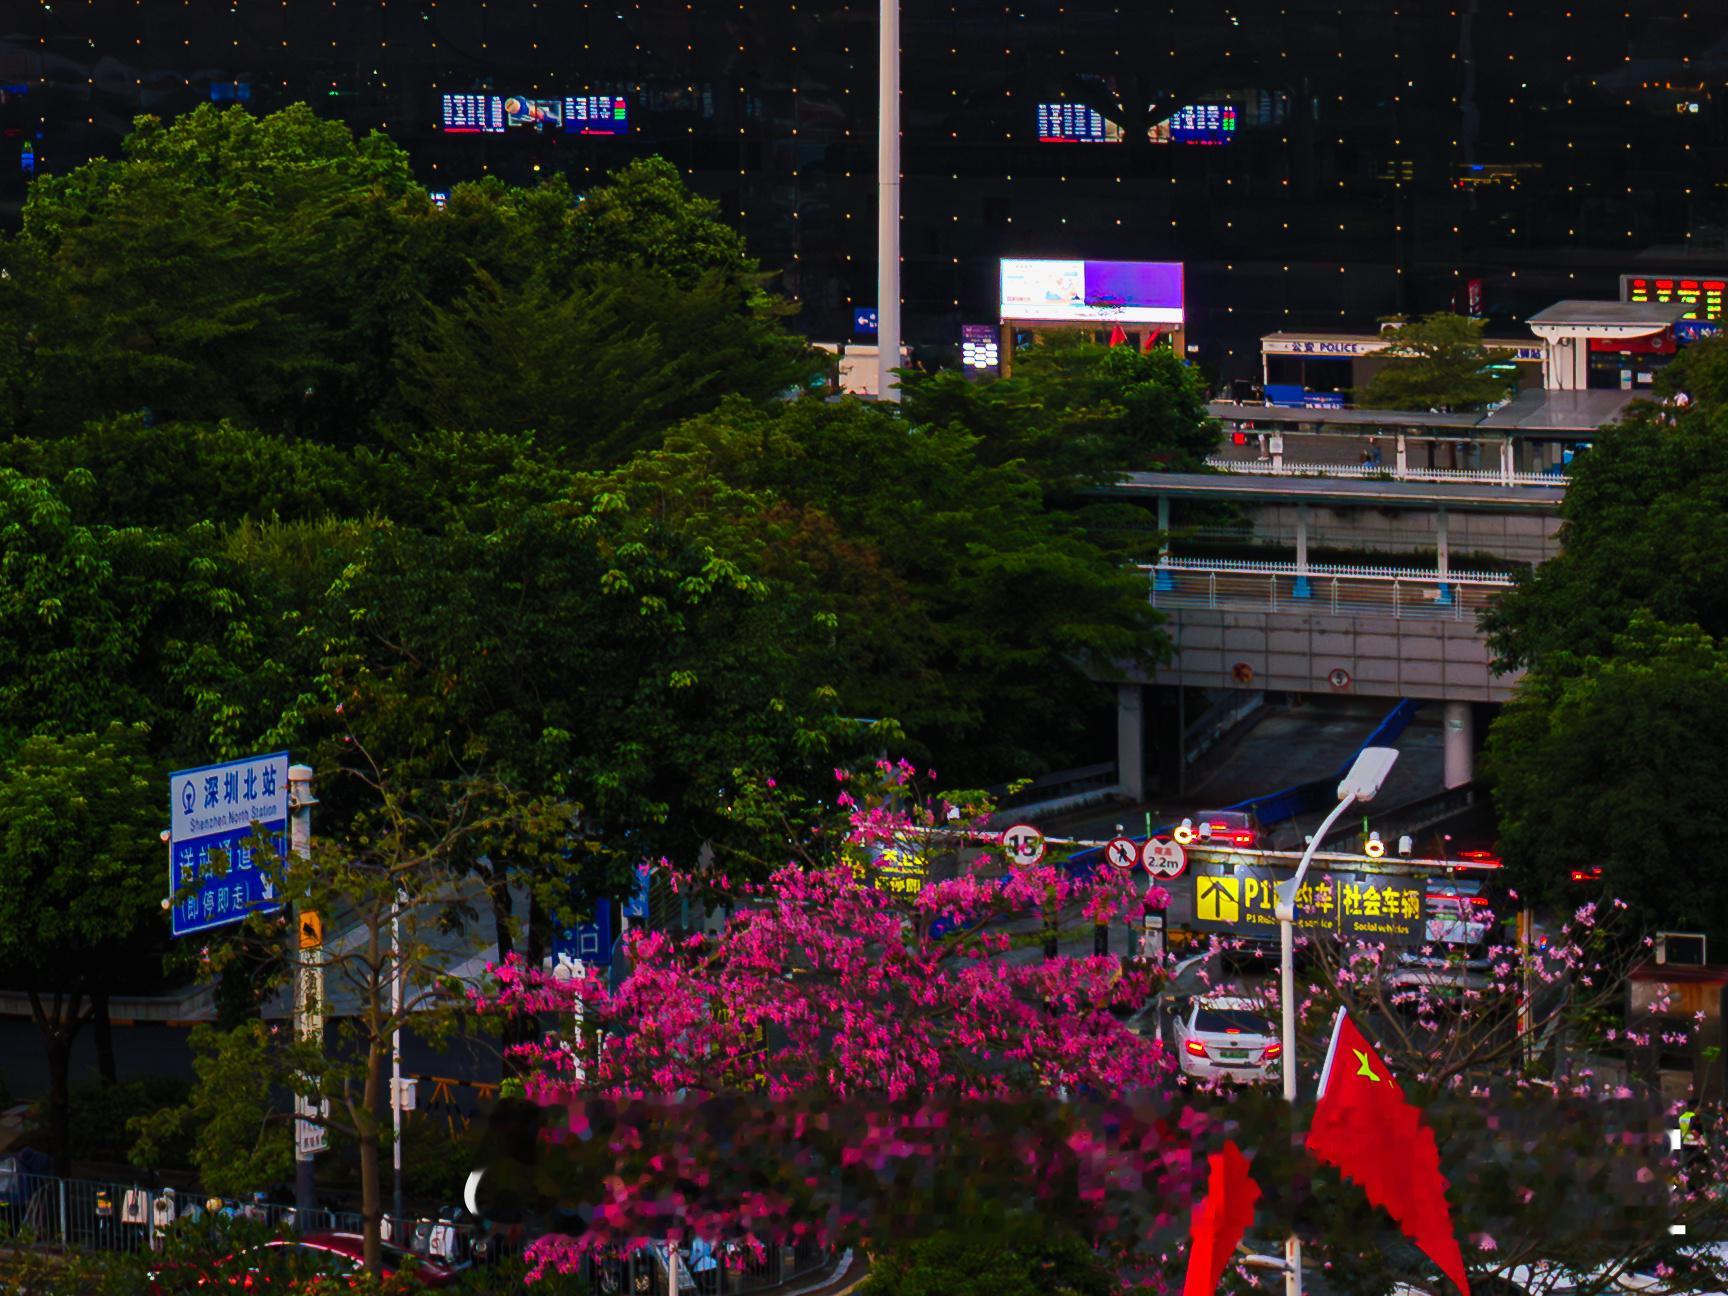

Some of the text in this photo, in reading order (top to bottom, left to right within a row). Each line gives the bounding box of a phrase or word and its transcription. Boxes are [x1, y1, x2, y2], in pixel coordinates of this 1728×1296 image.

[1320, 343, 1358, 354] POLICE
[203, 763, 277, 809] 深圳北站
[190, 803, 278, 833] Shenzhen North Station
[1008, 834, 1037, 857] 15
[1148, 856, 1179, 869] 2.2m
[1343, 883, 1421, 920] 社会车辆
[1353, 921, 1377, 932] Social
